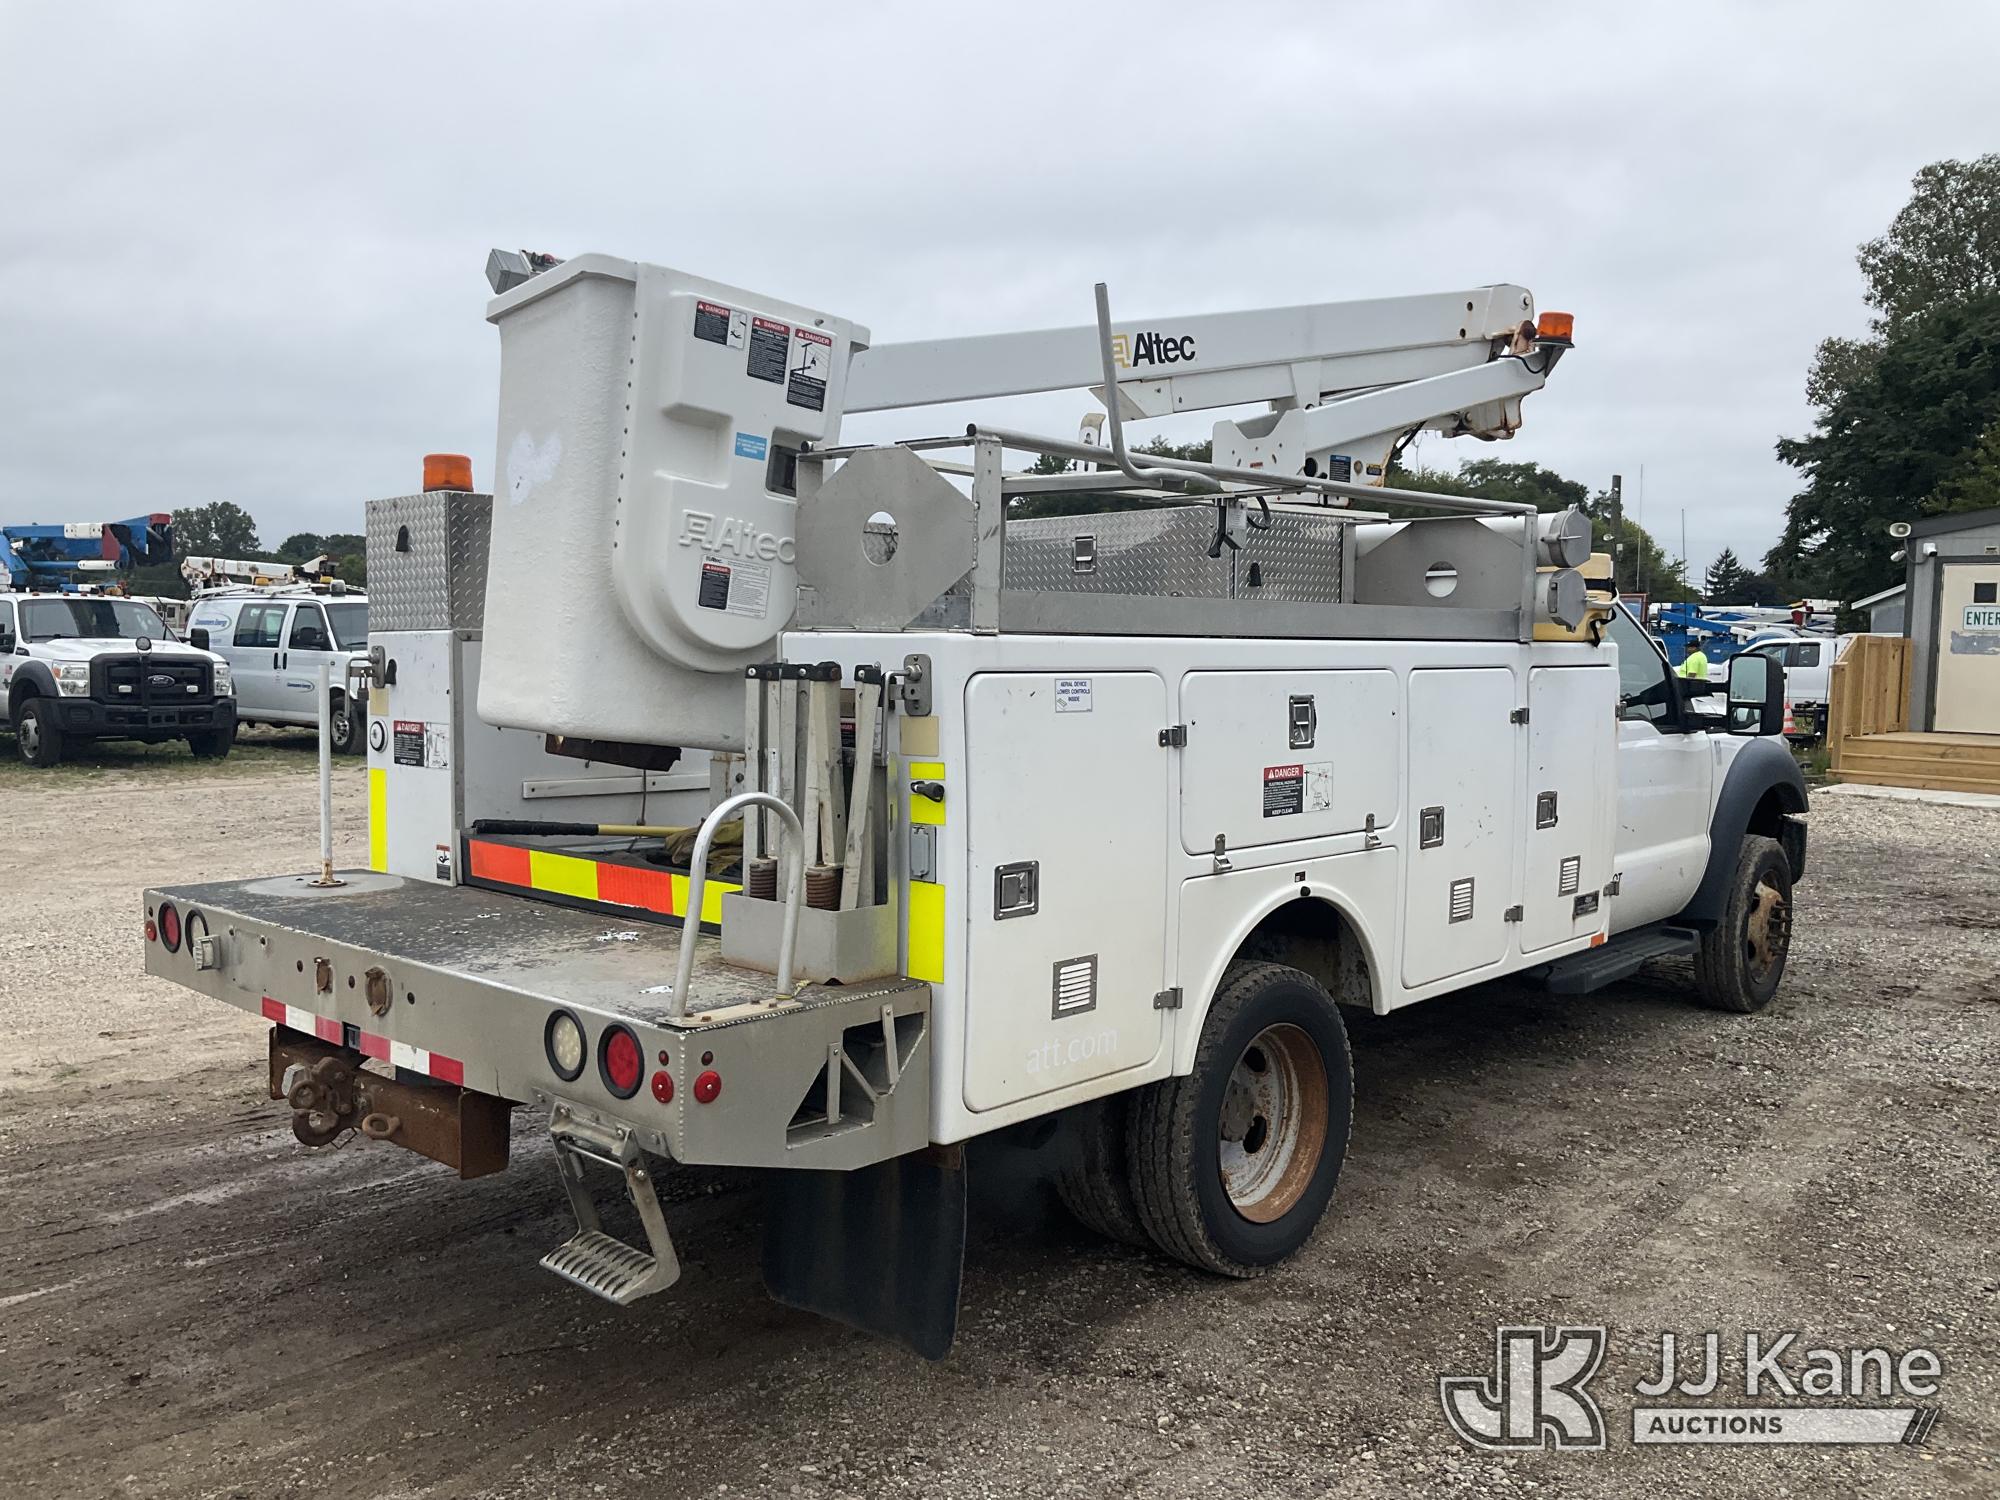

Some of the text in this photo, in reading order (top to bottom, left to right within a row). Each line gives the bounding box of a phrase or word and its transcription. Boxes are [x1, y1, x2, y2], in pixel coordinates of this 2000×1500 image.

[705, 304, 729, 316] DANGER
[763, 321, 785, 332] DANGER
[805, 332, 830, 345] DANGER
[1132, 332, 1196, 367] Altec
[715, 517, 796, 564] Altec
[1966, 611, 2000, 626] ENTER
[401, 722, 421, 732] DANGER
[1274, 767, 1300, 778] DANGER
[1026, 1028, 1119, 1073] att.com
